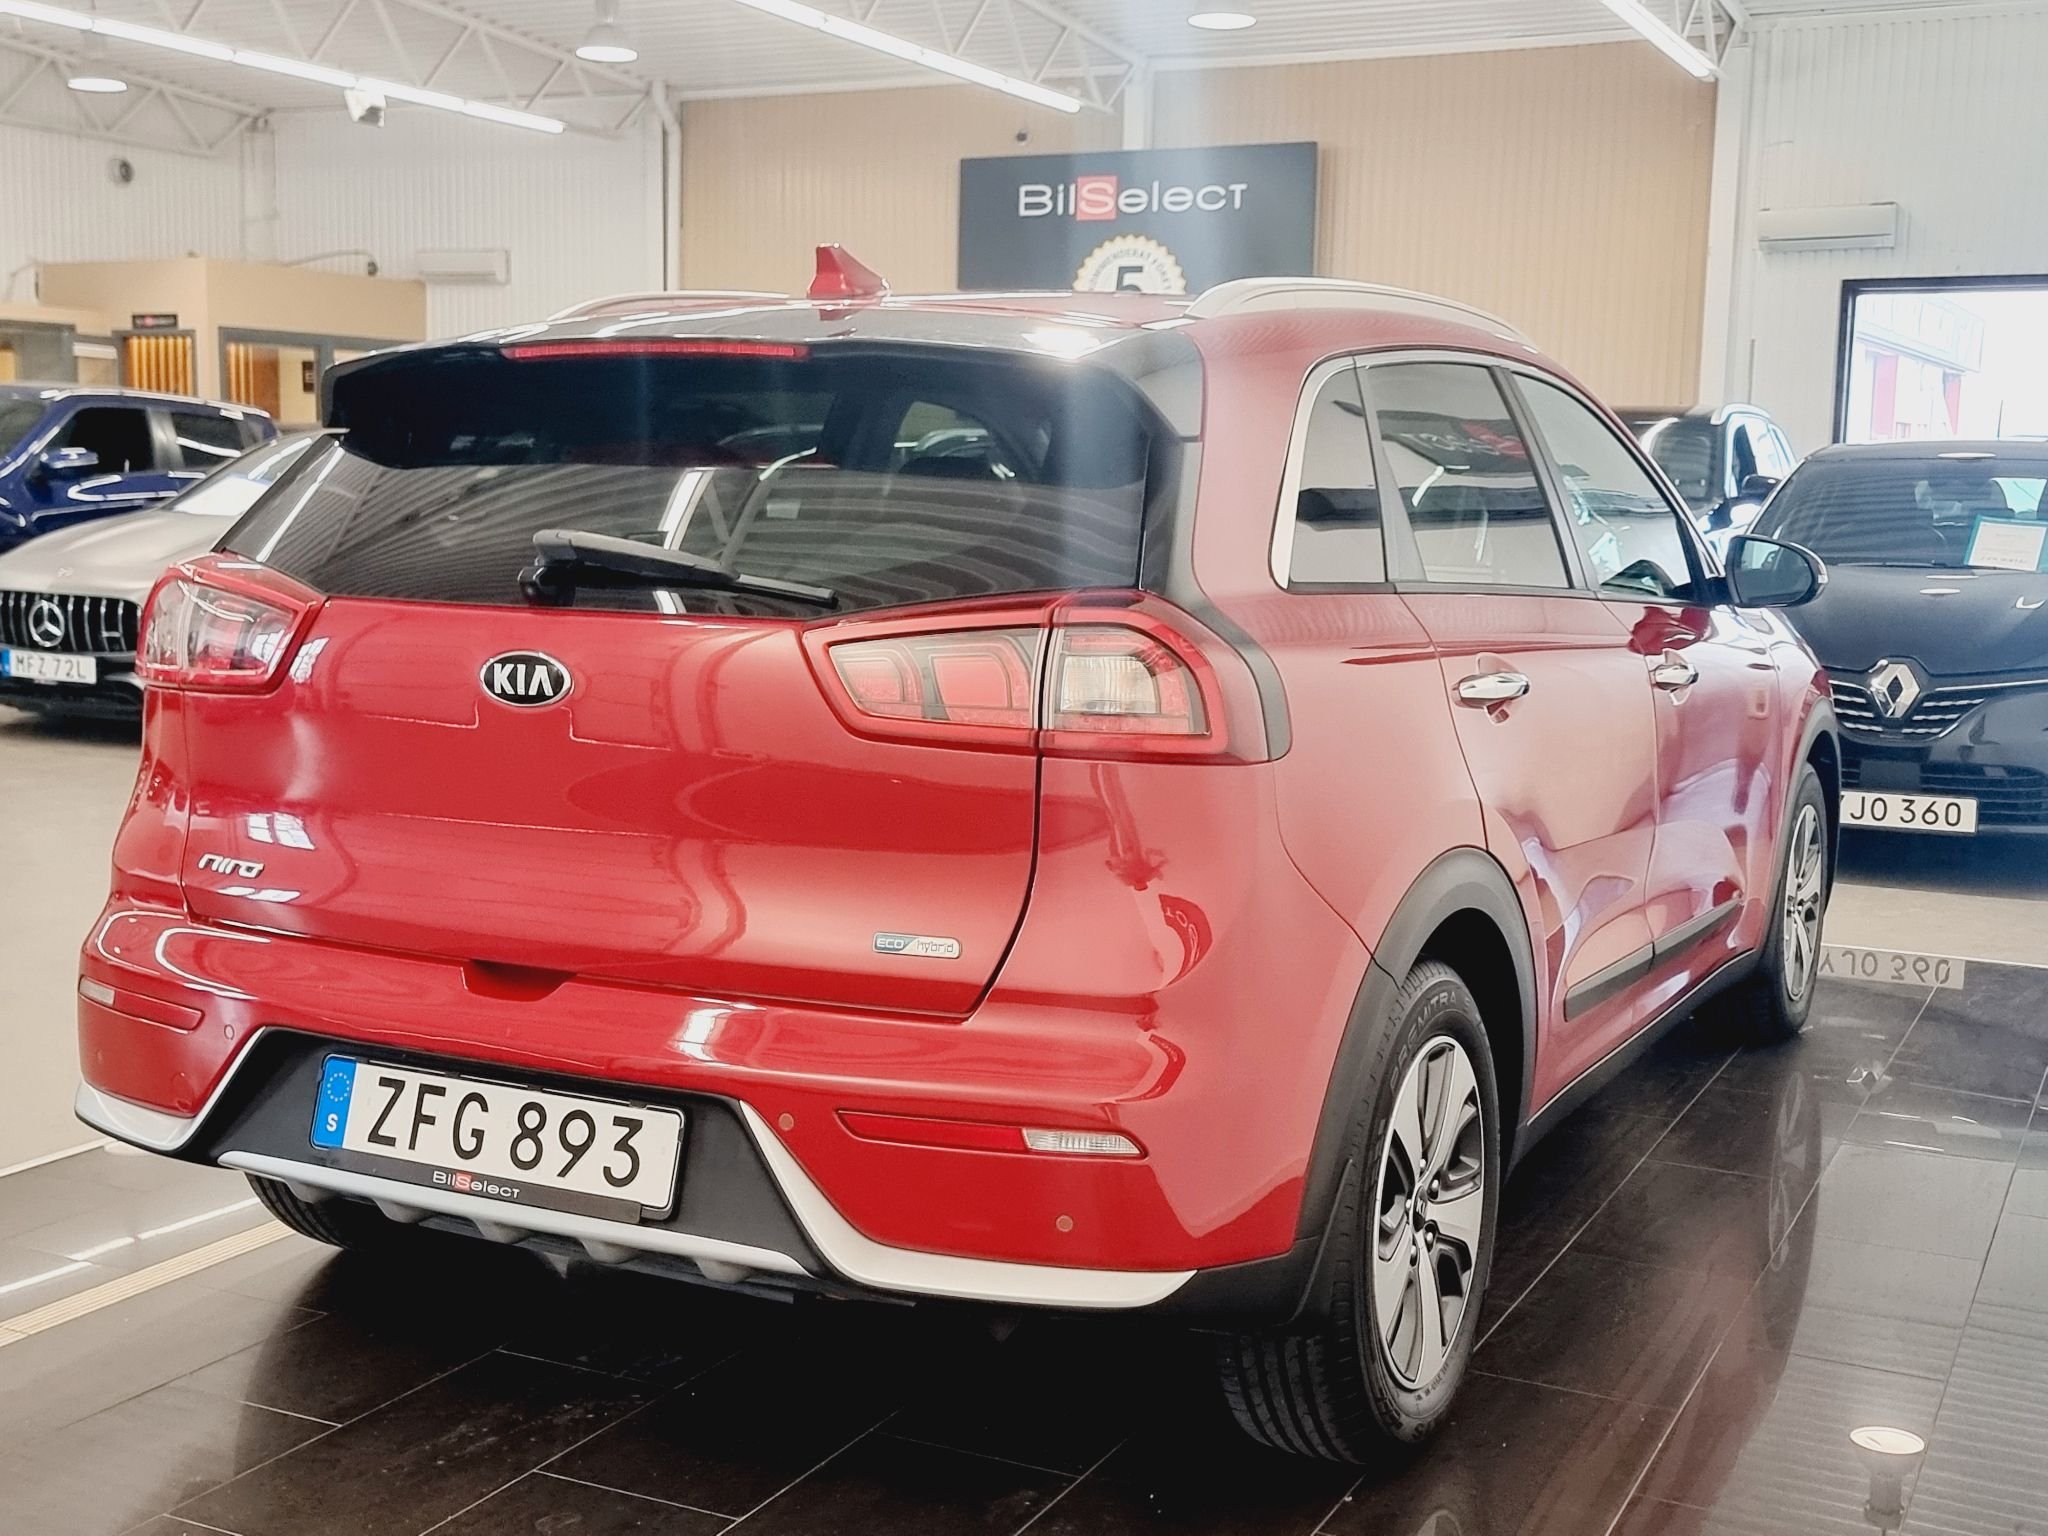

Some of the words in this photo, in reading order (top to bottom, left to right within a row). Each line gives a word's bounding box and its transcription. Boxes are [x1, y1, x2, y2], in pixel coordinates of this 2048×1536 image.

[1017, 179, 1249, 218] BilSelect
[15, 655, 46, 677] MFZ
[493, 662, 555, 697] KIA
[1841, 795, 1888, 822] JO
[1900, 799, 1962, 827] 360
[876, 937, 905, 950] ECO
[916, 939, 954, 954] hybrid
[326, 1113, 339, 1132] S
[367, 1076, 490, 1161] ZFG
[509, 1101, 644, 1188] 893
[432, 1169, 521, 1199] BilSelect
